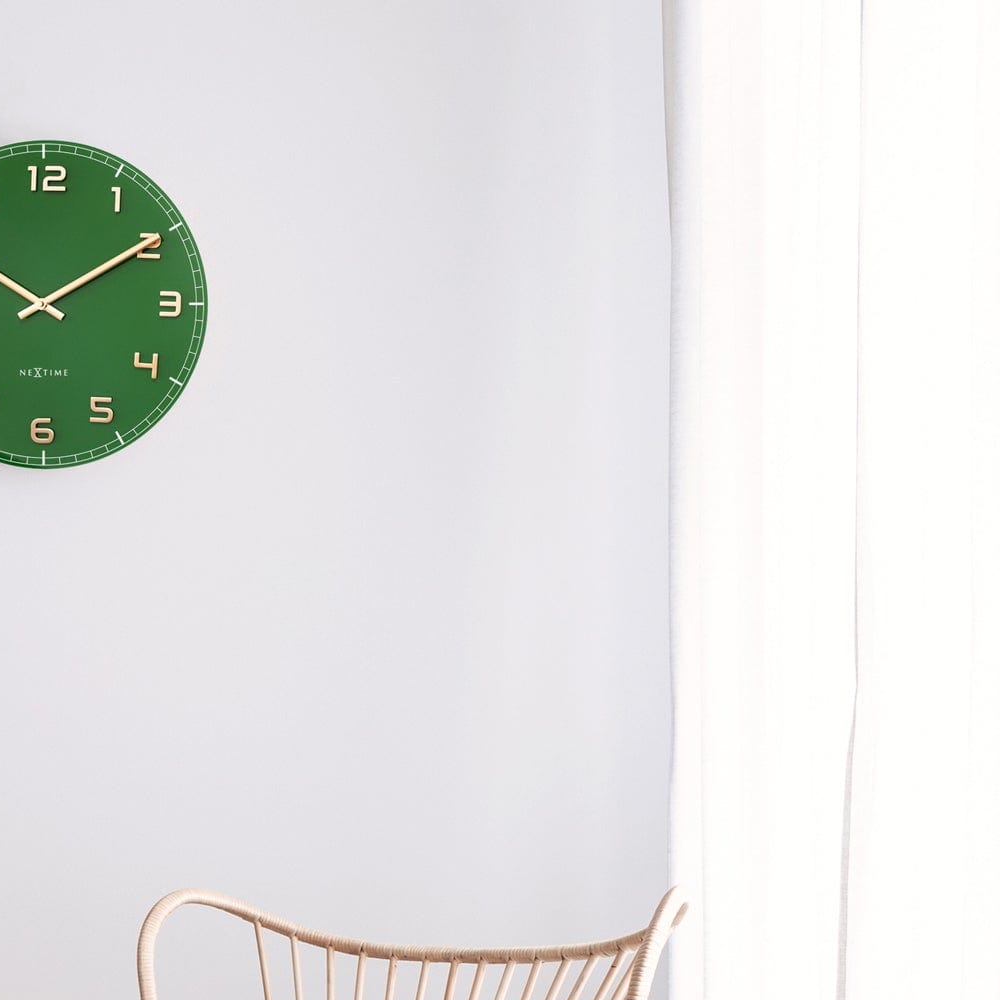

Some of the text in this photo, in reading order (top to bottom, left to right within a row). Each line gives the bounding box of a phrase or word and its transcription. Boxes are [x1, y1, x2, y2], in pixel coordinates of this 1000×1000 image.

[28, 166, 67, 192] 12
[111, 186, 121, 212] 1
[159, 290, 182, 317] 3
[19, 367, 68, 378] NEXTIME
[133, 352, 159, 379] 4
[89, 396, 114, 423] 5
[30, 418, 55, 444] 6
